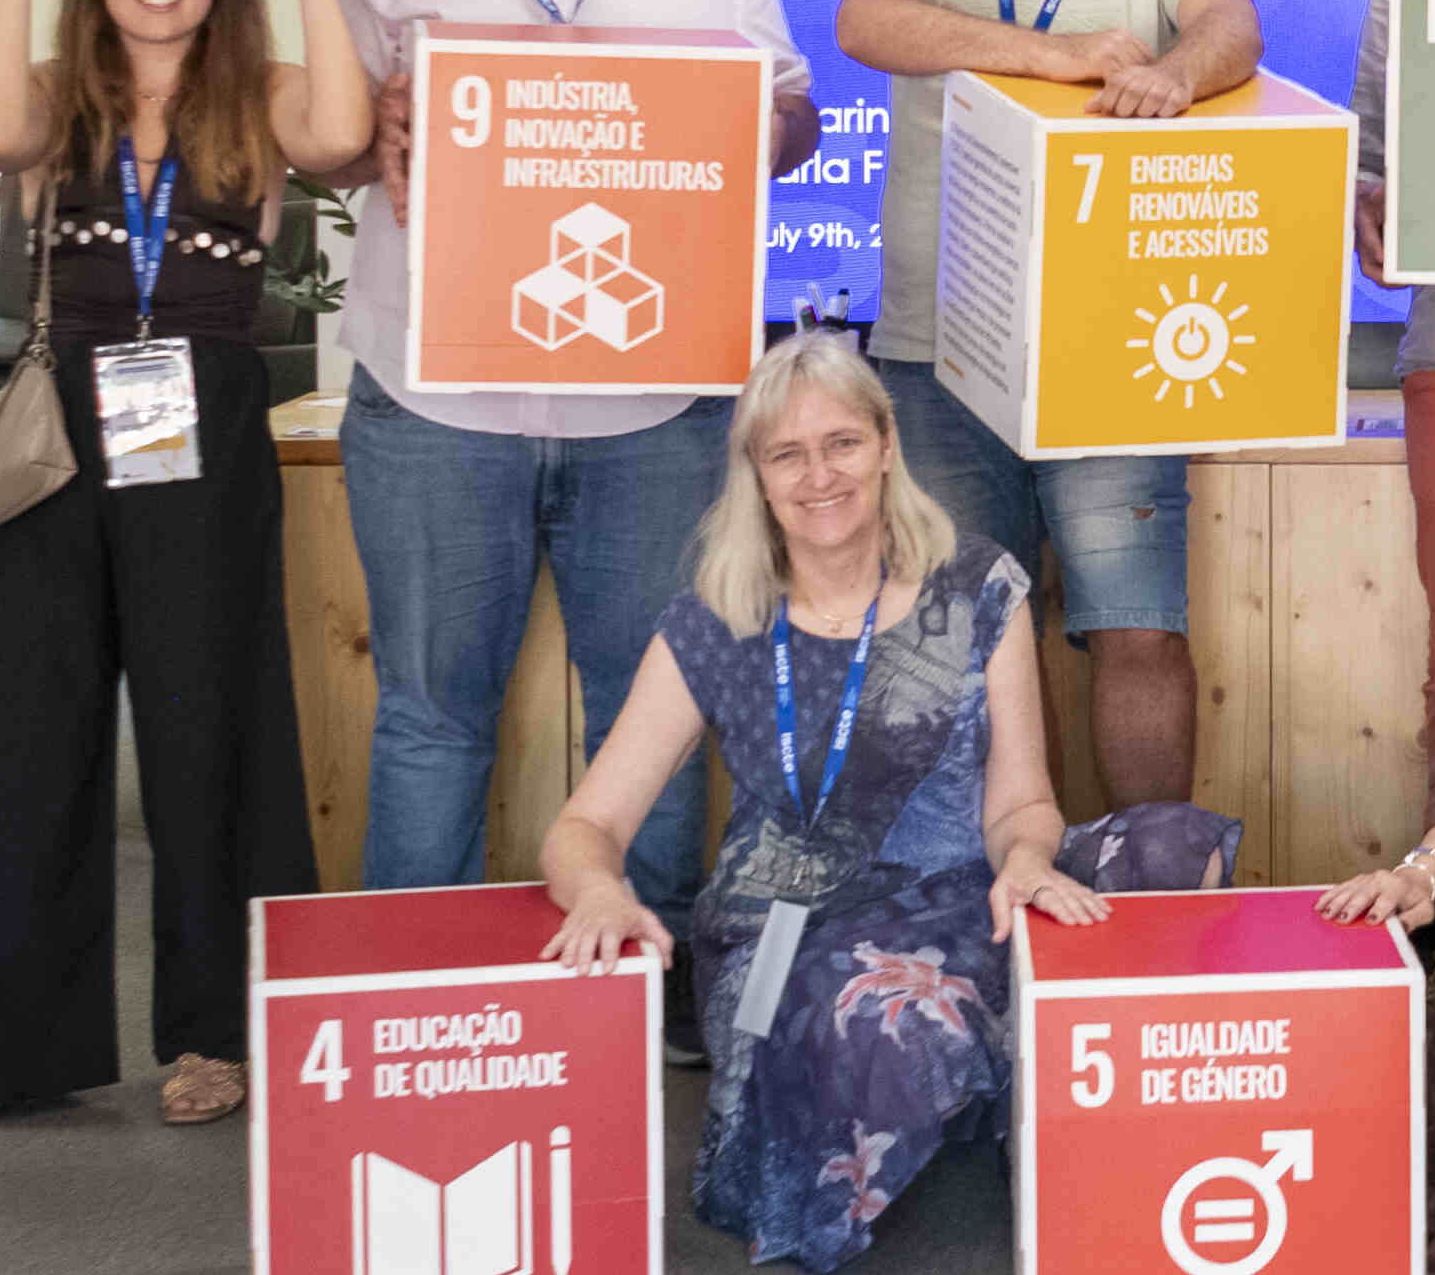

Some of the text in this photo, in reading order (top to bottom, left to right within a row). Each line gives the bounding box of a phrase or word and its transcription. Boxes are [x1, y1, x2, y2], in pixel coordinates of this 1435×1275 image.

[450, 74, 493, 149] 9
[505, 71, 639, 116] INDÚSTRIA,
[504, 112, 646, 157] INOVAÇÃO E
[502, 157, 724, 191] INFRAESTRUTURAS
[1072, 153, 1104, 224] 7
[1130, 153, 1234, 185] ENERGIAS
[1128, 184, 1259, 222] RENOVÁVEIS
[766, 222, 803, 253] uly
[808, 222, 862, 250] 9th,
[1128, 222, 1270, 260] E ACESSÍVEIS
[373, 1003, 523, 1057] EDUCAÇÃO
[1140, 1019, 1292, 1060] IGUALDADE
[299, 1019, 352, 1103] 4
[373, 1050, 569, 1100] DE QUALIDADE
[1070, 1022, 1115, 1109] 5
[1140, 1058, 1288, 1106] DE GÉNERO
